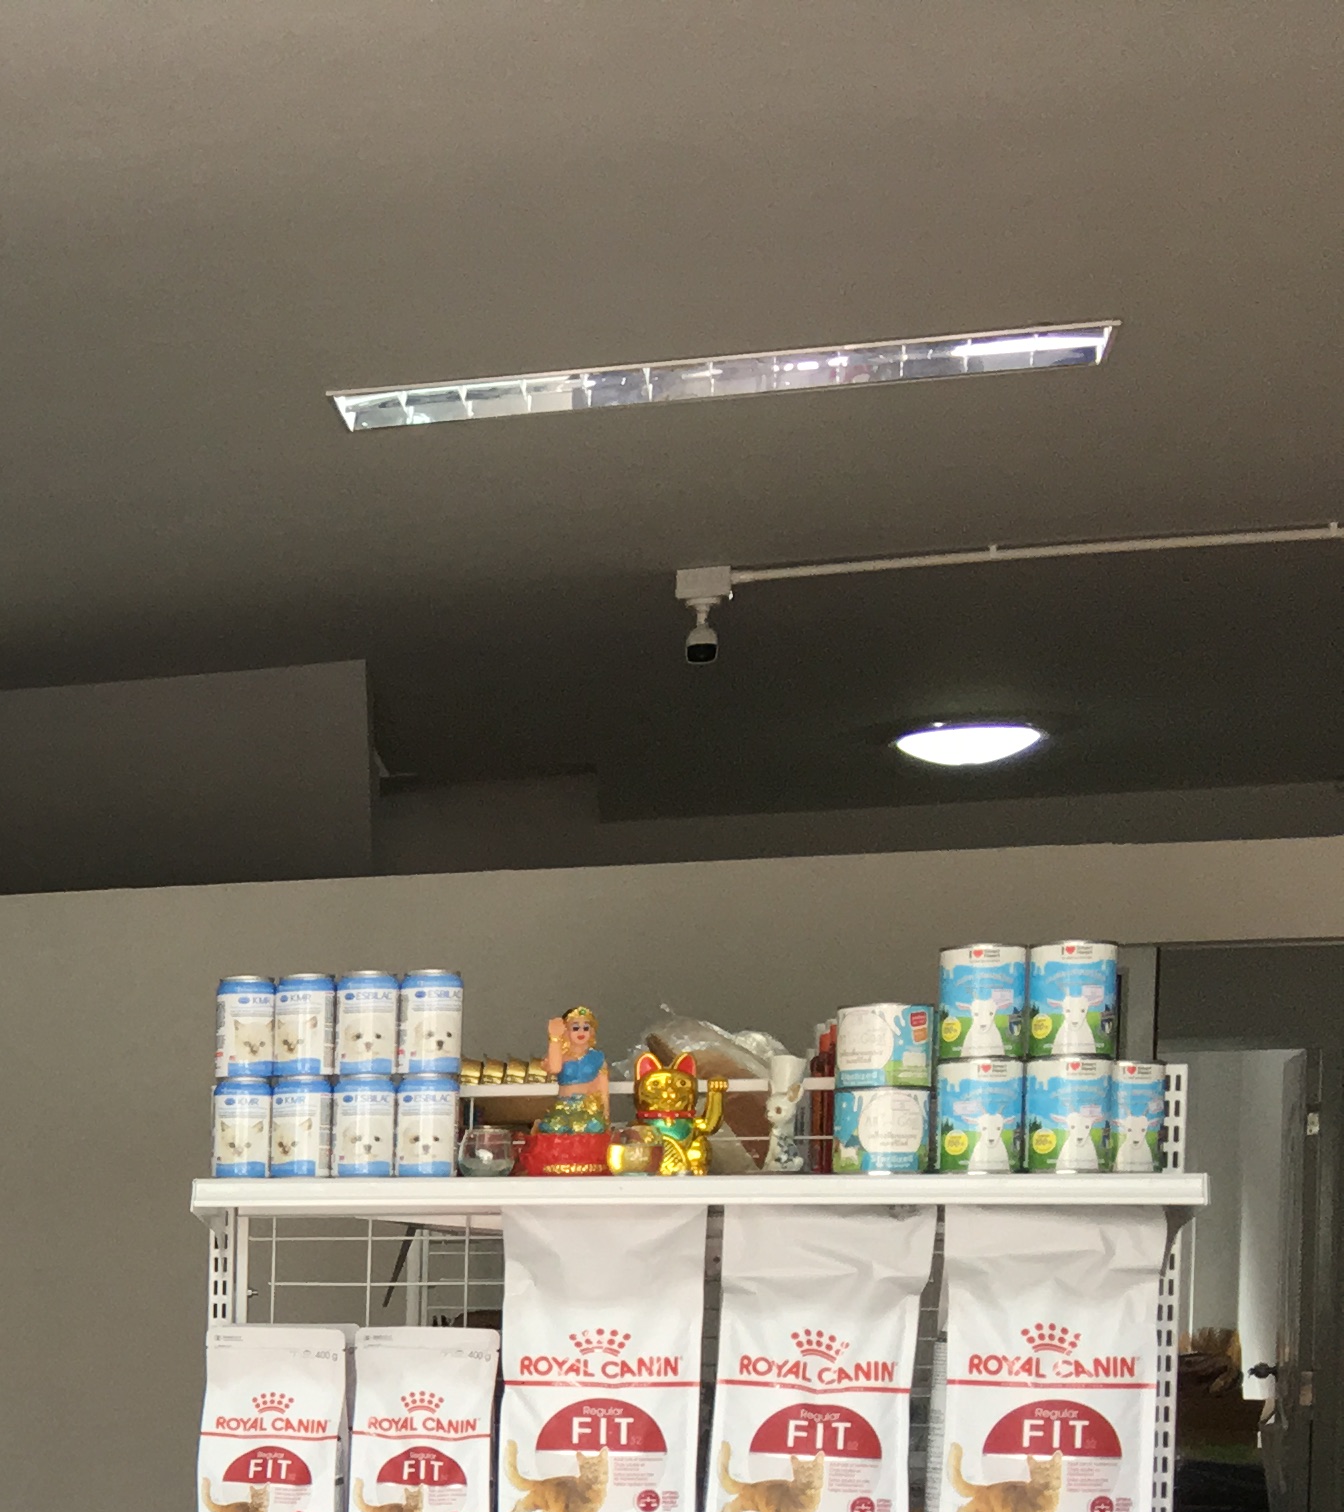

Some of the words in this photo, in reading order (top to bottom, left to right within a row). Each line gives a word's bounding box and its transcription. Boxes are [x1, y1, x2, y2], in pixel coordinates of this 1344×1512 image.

[520, 1356, 595, 1377] ROYAL
[601, 1356, 680, 1379] CANIN
[739, 1354, 811, 1383] ROYAL
[818, 1361, 895, 1385] CANIN
[968, 1354, 1046, 1378] ROYAL
[1053, 1356, 1135, 1379] CANIN
[582, 1406, 624, 1417] Regular
[1035, 1408, 1078, 1419] Regular
[215, 1416, 267, 1431] ROYAL
[272, 1418, 328, 1433] CANIN
[368, 1416, 417, 1431] ROYAL
[422, 1417, 477, 1433] CANIN
[571, 1417, 634, 1445] FIT
[787, 1420, 852, 1450] FIT
[1023, 1419, 1090, 1448] FIT
[249, 1459, 292, 1479] FIT
[403, 1460, 444, 1481] FIT
